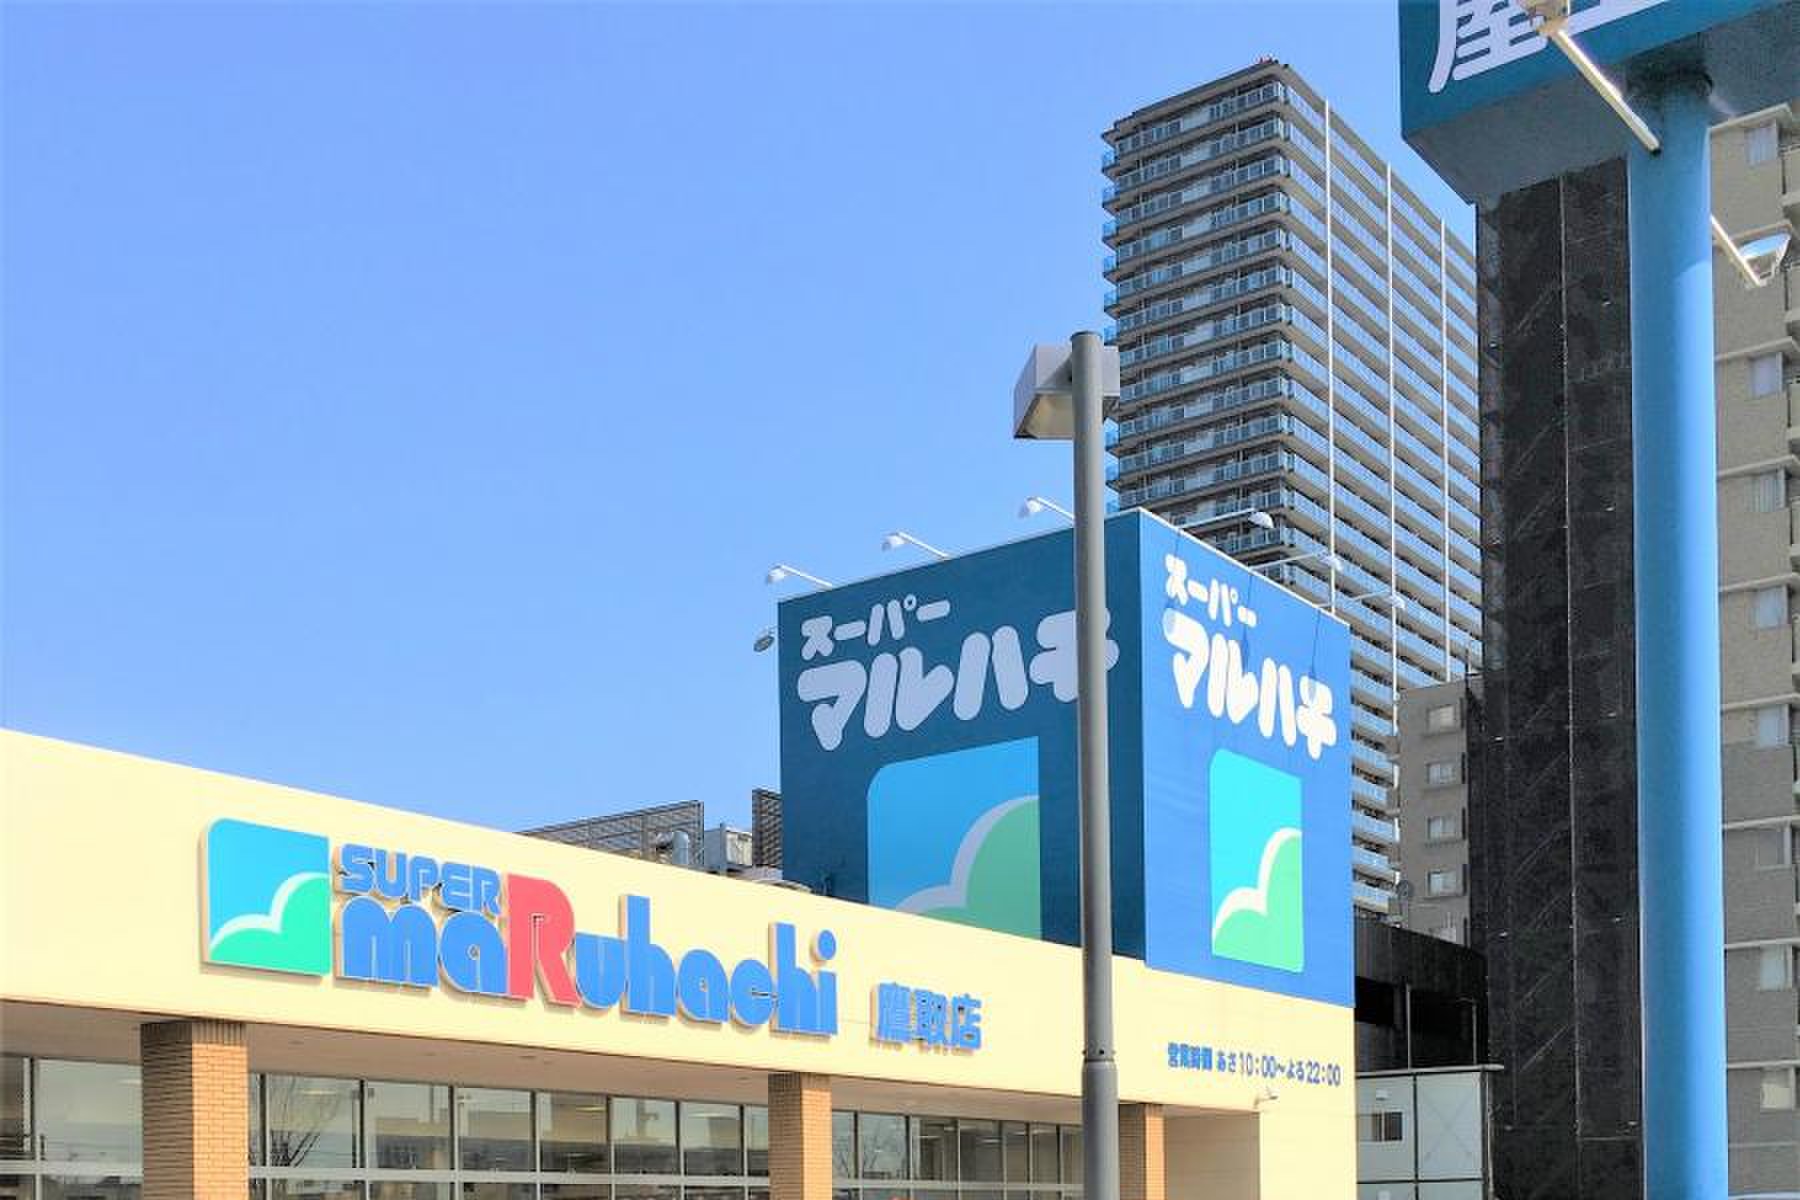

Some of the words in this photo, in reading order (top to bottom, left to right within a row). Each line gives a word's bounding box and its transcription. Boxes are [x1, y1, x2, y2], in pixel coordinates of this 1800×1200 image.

[801, 594, 950, 661] スーパー
[1165, 554, 1257, 627] スーパー
[797, 608, 1119, 750] マルハチ
[1162, 607, 1337, 760] マルハチ
[340, 843, 502, 916] SUPER
[341, 872, 838, 1036] maRuhachi
